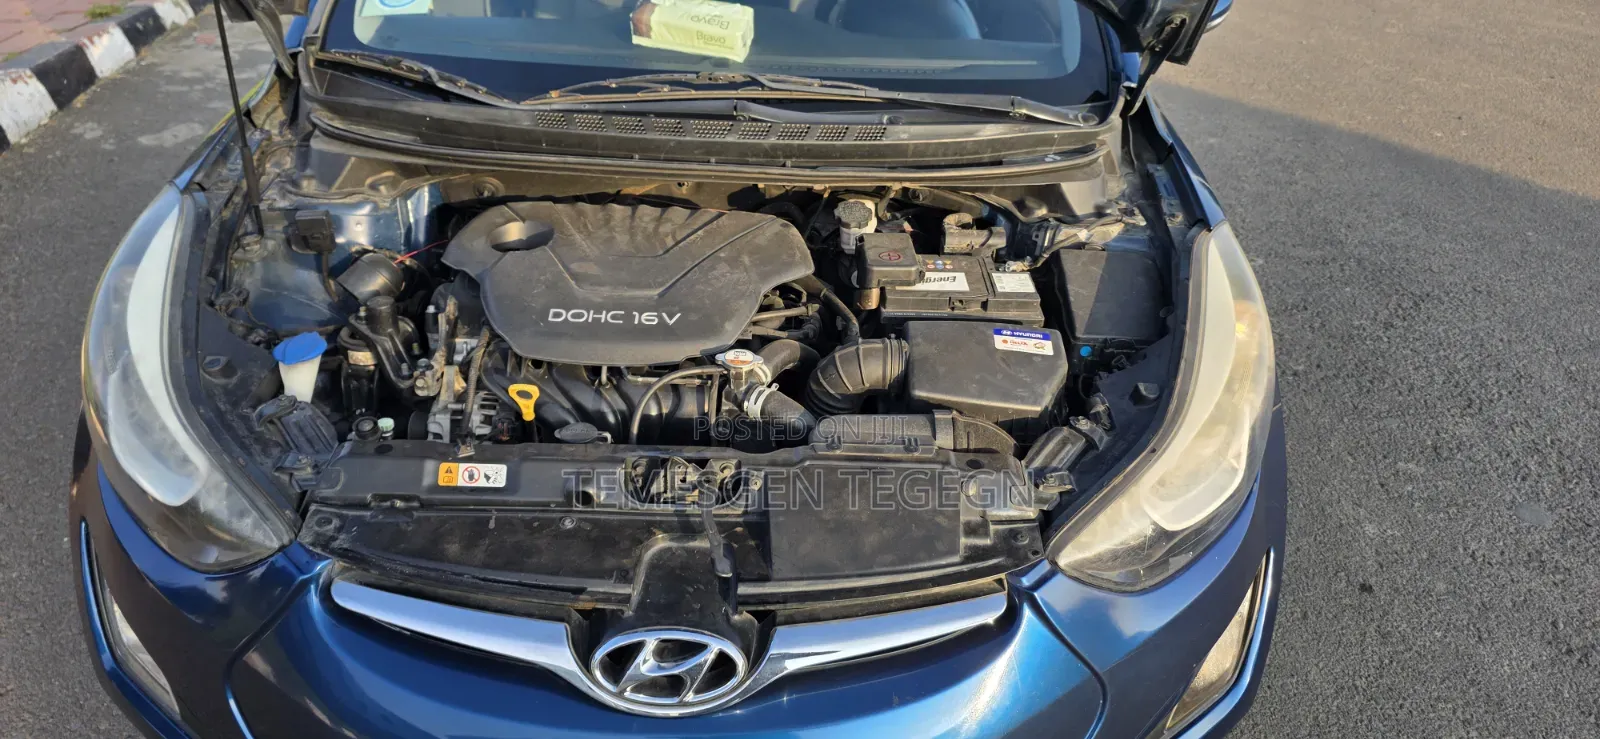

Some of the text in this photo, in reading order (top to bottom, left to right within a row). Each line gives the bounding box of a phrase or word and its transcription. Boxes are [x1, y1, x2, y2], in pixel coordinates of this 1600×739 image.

[691, 15, 730, 30] Bravo
[696, 30, 726, 44] Bravo
[548, 308, 682, 326] DOHC 16V
[1013, 331, 1043, 339] HYUNDAI
